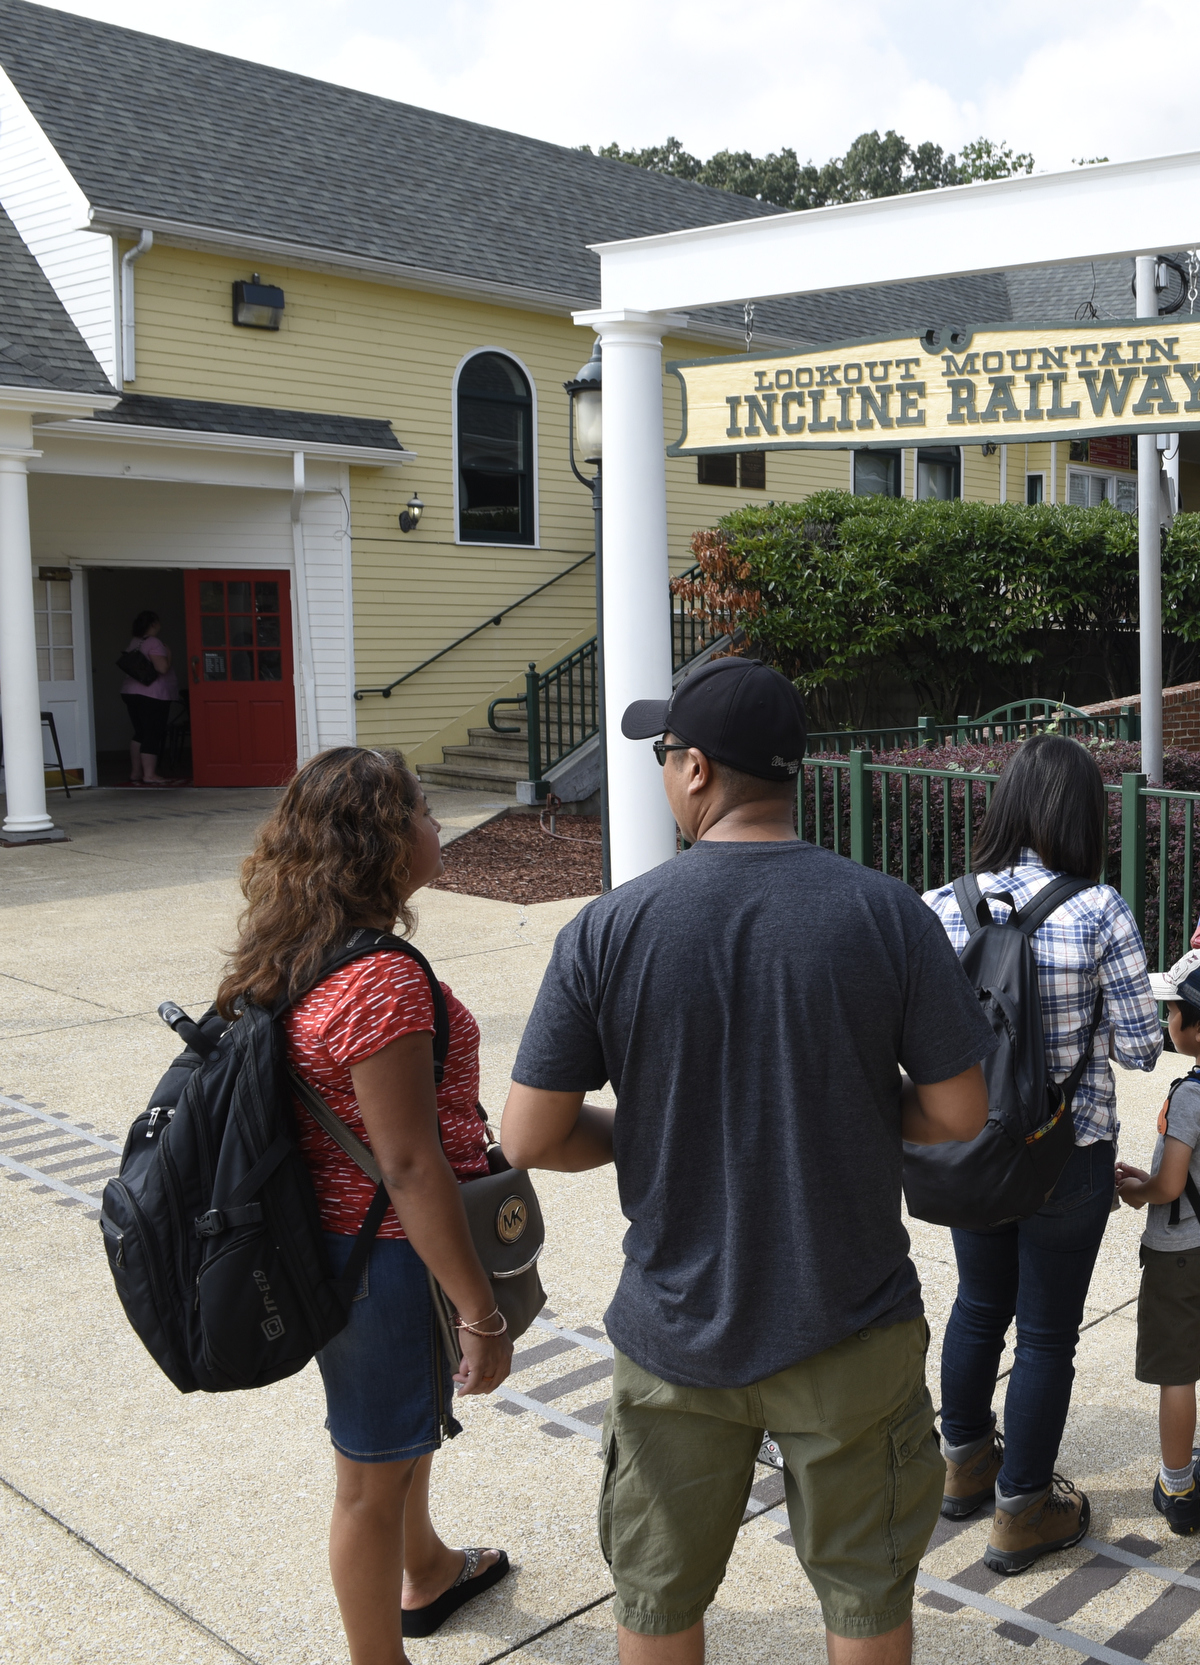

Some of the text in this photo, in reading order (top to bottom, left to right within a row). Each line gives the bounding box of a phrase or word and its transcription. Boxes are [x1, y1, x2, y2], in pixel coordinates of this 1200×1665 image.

[753, 336, 1181, 392] LOOKOUT MOUNTAIN
[725, 381, 927, 437] INCLINE
